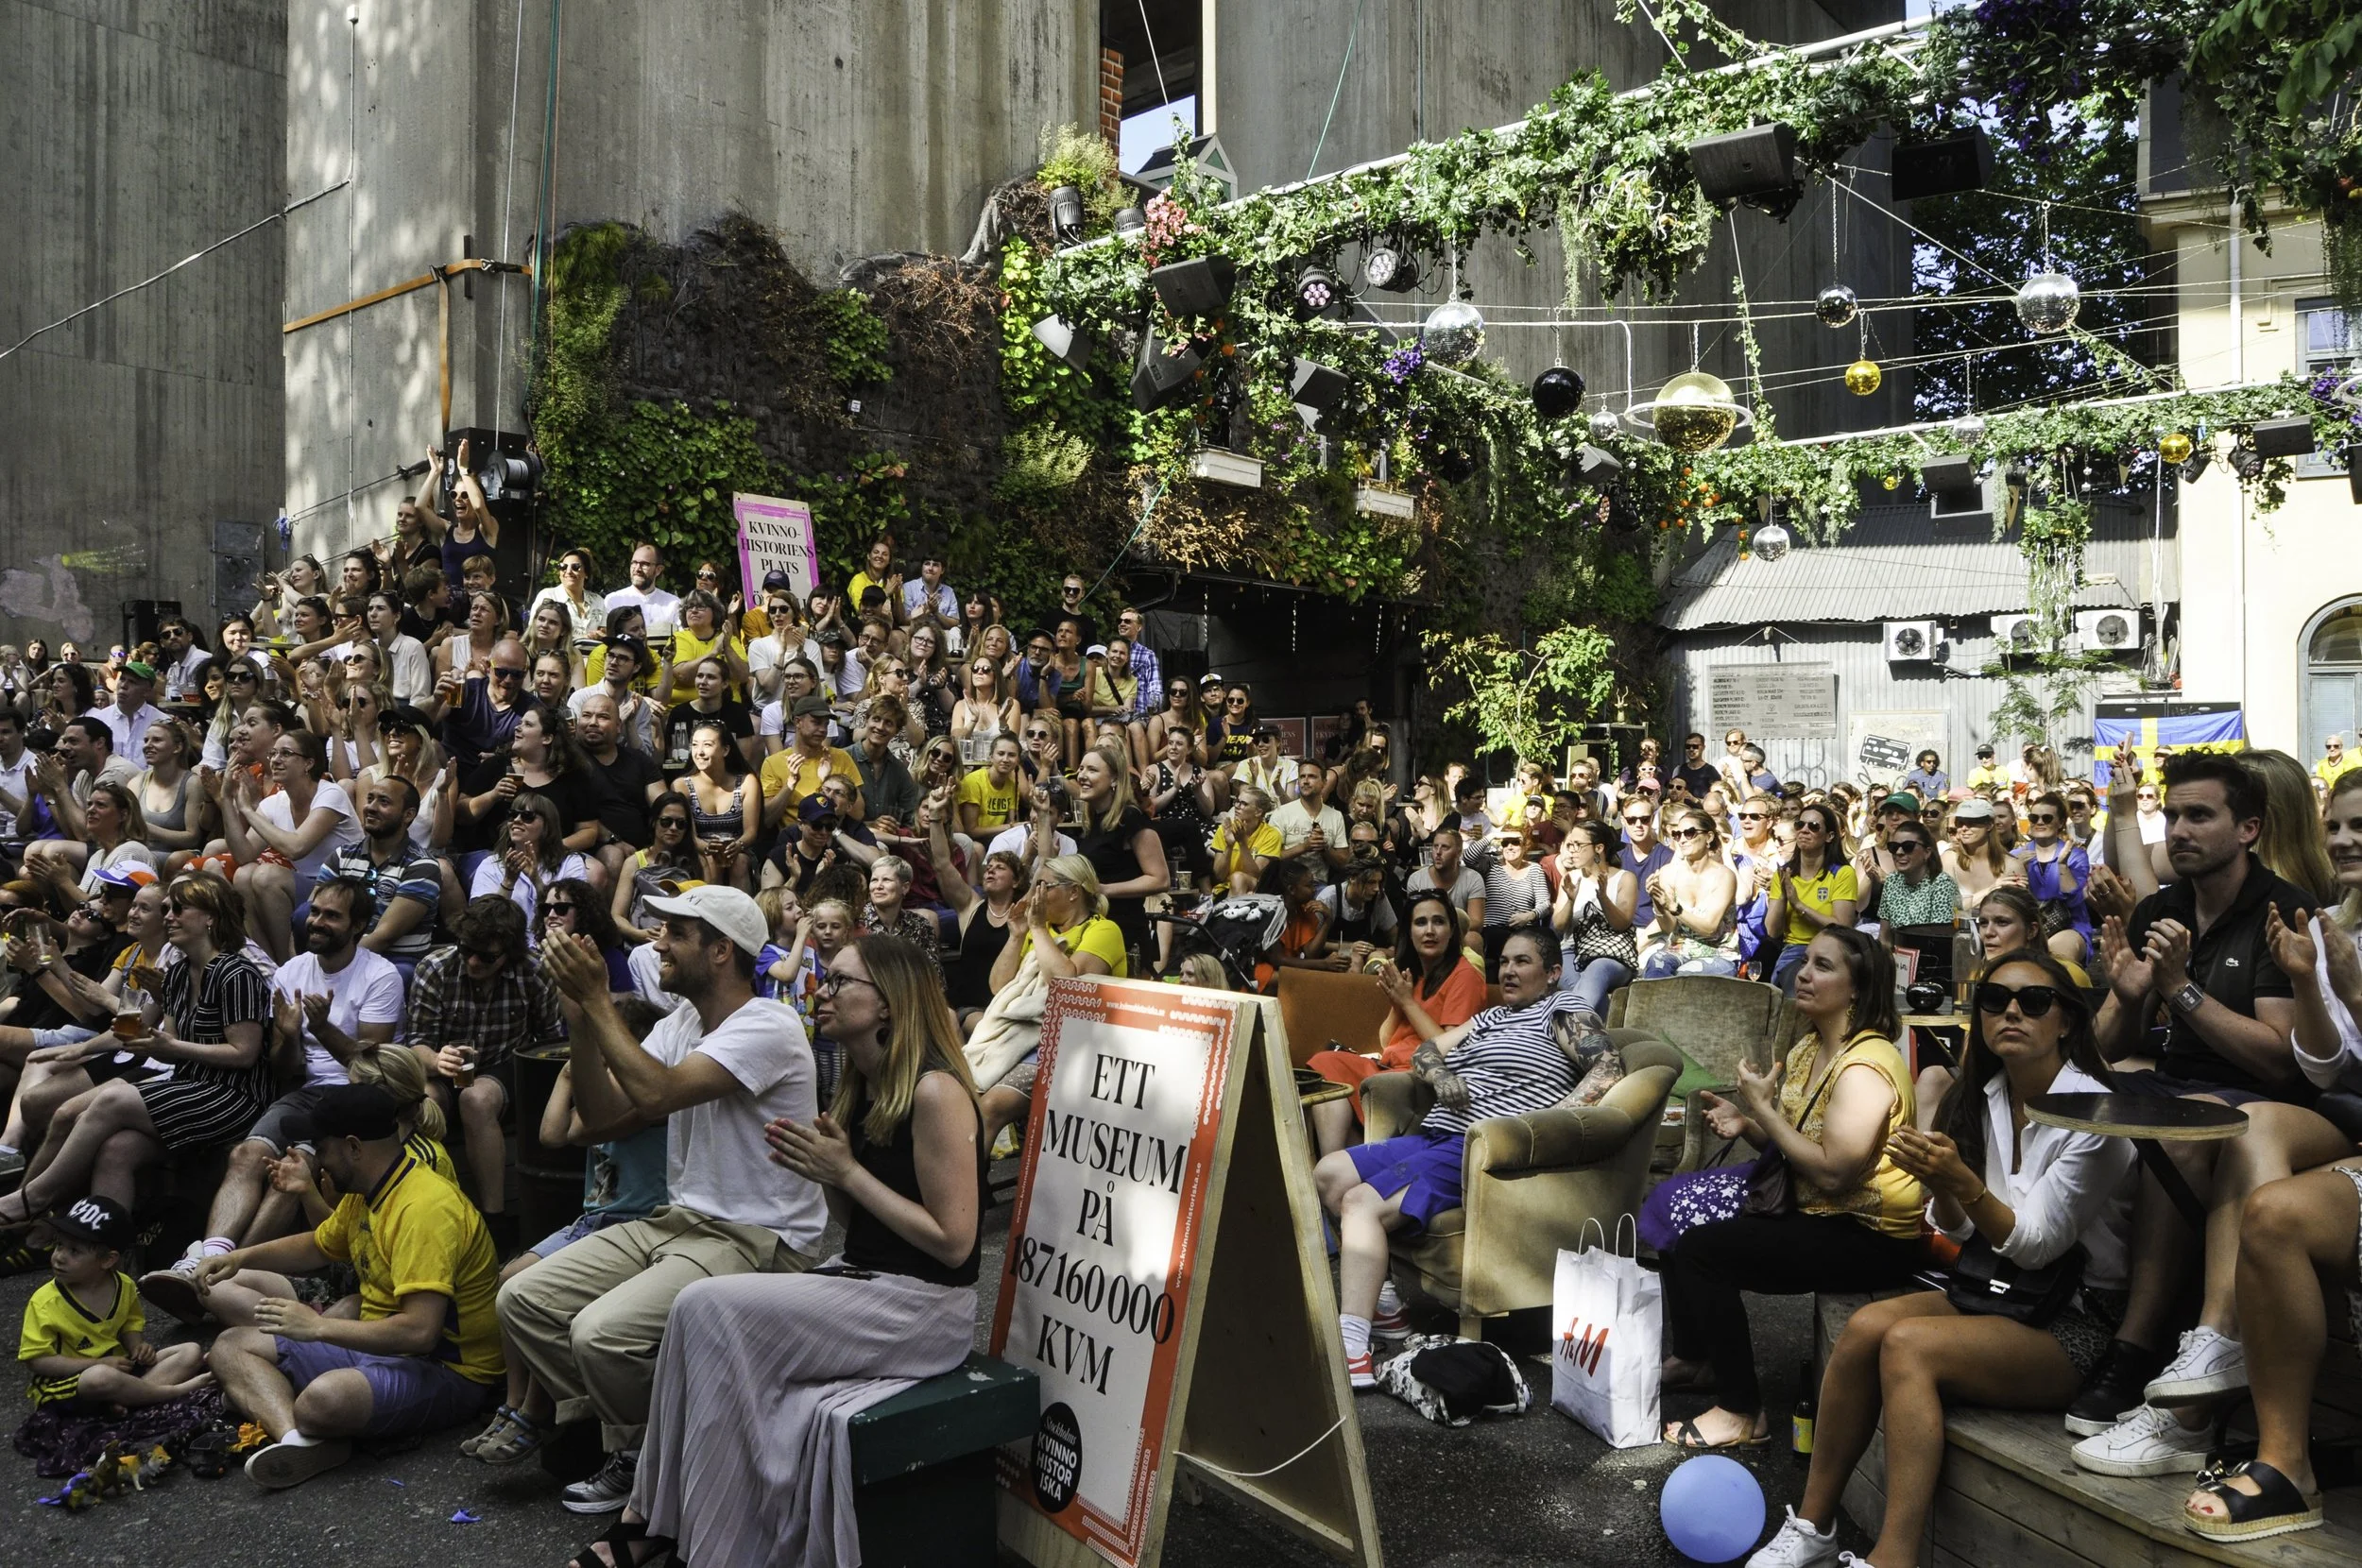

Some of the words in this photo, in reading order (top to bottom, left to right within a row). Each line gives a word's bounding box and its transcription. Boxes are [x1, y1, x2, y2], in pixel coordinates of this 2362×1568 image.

[741, 537, 814, 558] HISTORIENS
[748, 520, 801, 538] KVINNO-
[761, 558, 799, 574] PLATS
[1090, 1053, 1155, 1110] ETT
[1042, 1109, 1187, 1194] MUSEUM
[1076, 1180, 1114, 1247] PÅ
[1175, 1162, 1202, 1288] www.kvinnohistoriska.se
[1036, 1314, 1114, 1395] KVM
[1560, 1317, 1609, 1377] H&M
[1044, 1416, 1076, 1445] Stockholms
[1037, 1431, 1077, 1469] KVINNO
[1036, 1451, 1072, 1488] HISTOR
[1039, 1474, 1062, 1501] ISKA
